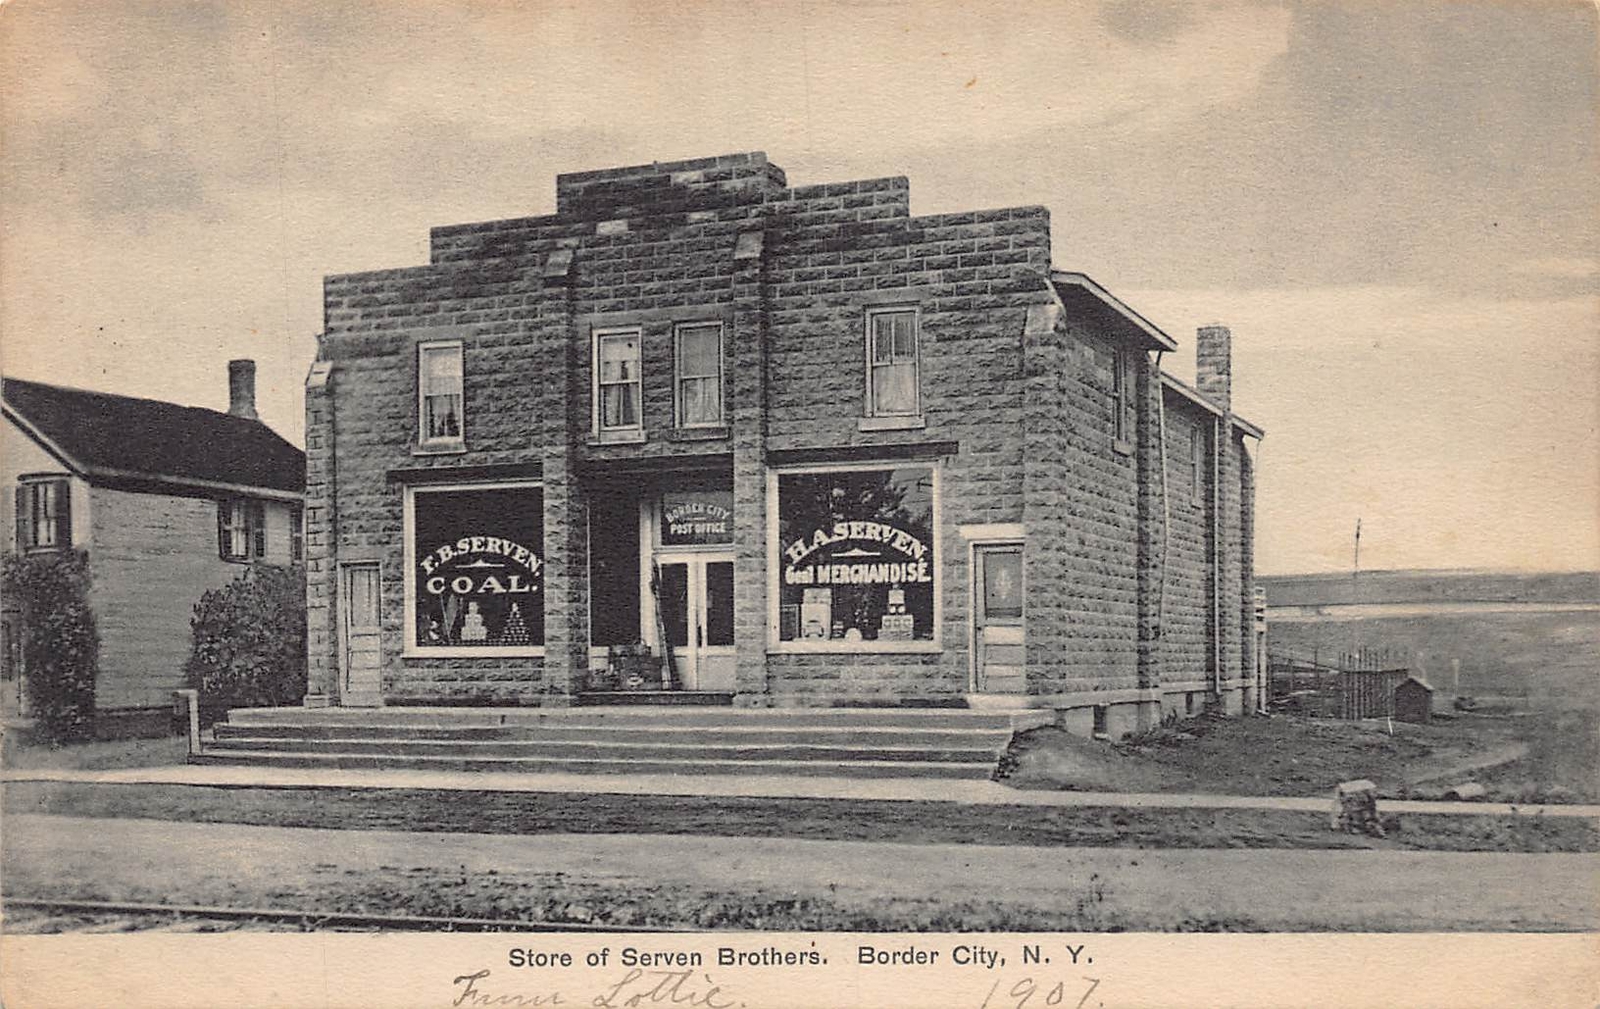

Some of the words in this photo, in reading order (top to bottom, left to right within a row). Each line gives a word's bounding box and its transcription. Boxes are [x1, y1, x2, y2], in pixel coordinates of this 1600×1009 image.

[706, 504, 731, 520] CITY
[670, 523, 694, 535] POST
[695, 522, 726, 534] OFFICE
[426, 575, 538, 594] COAL.
